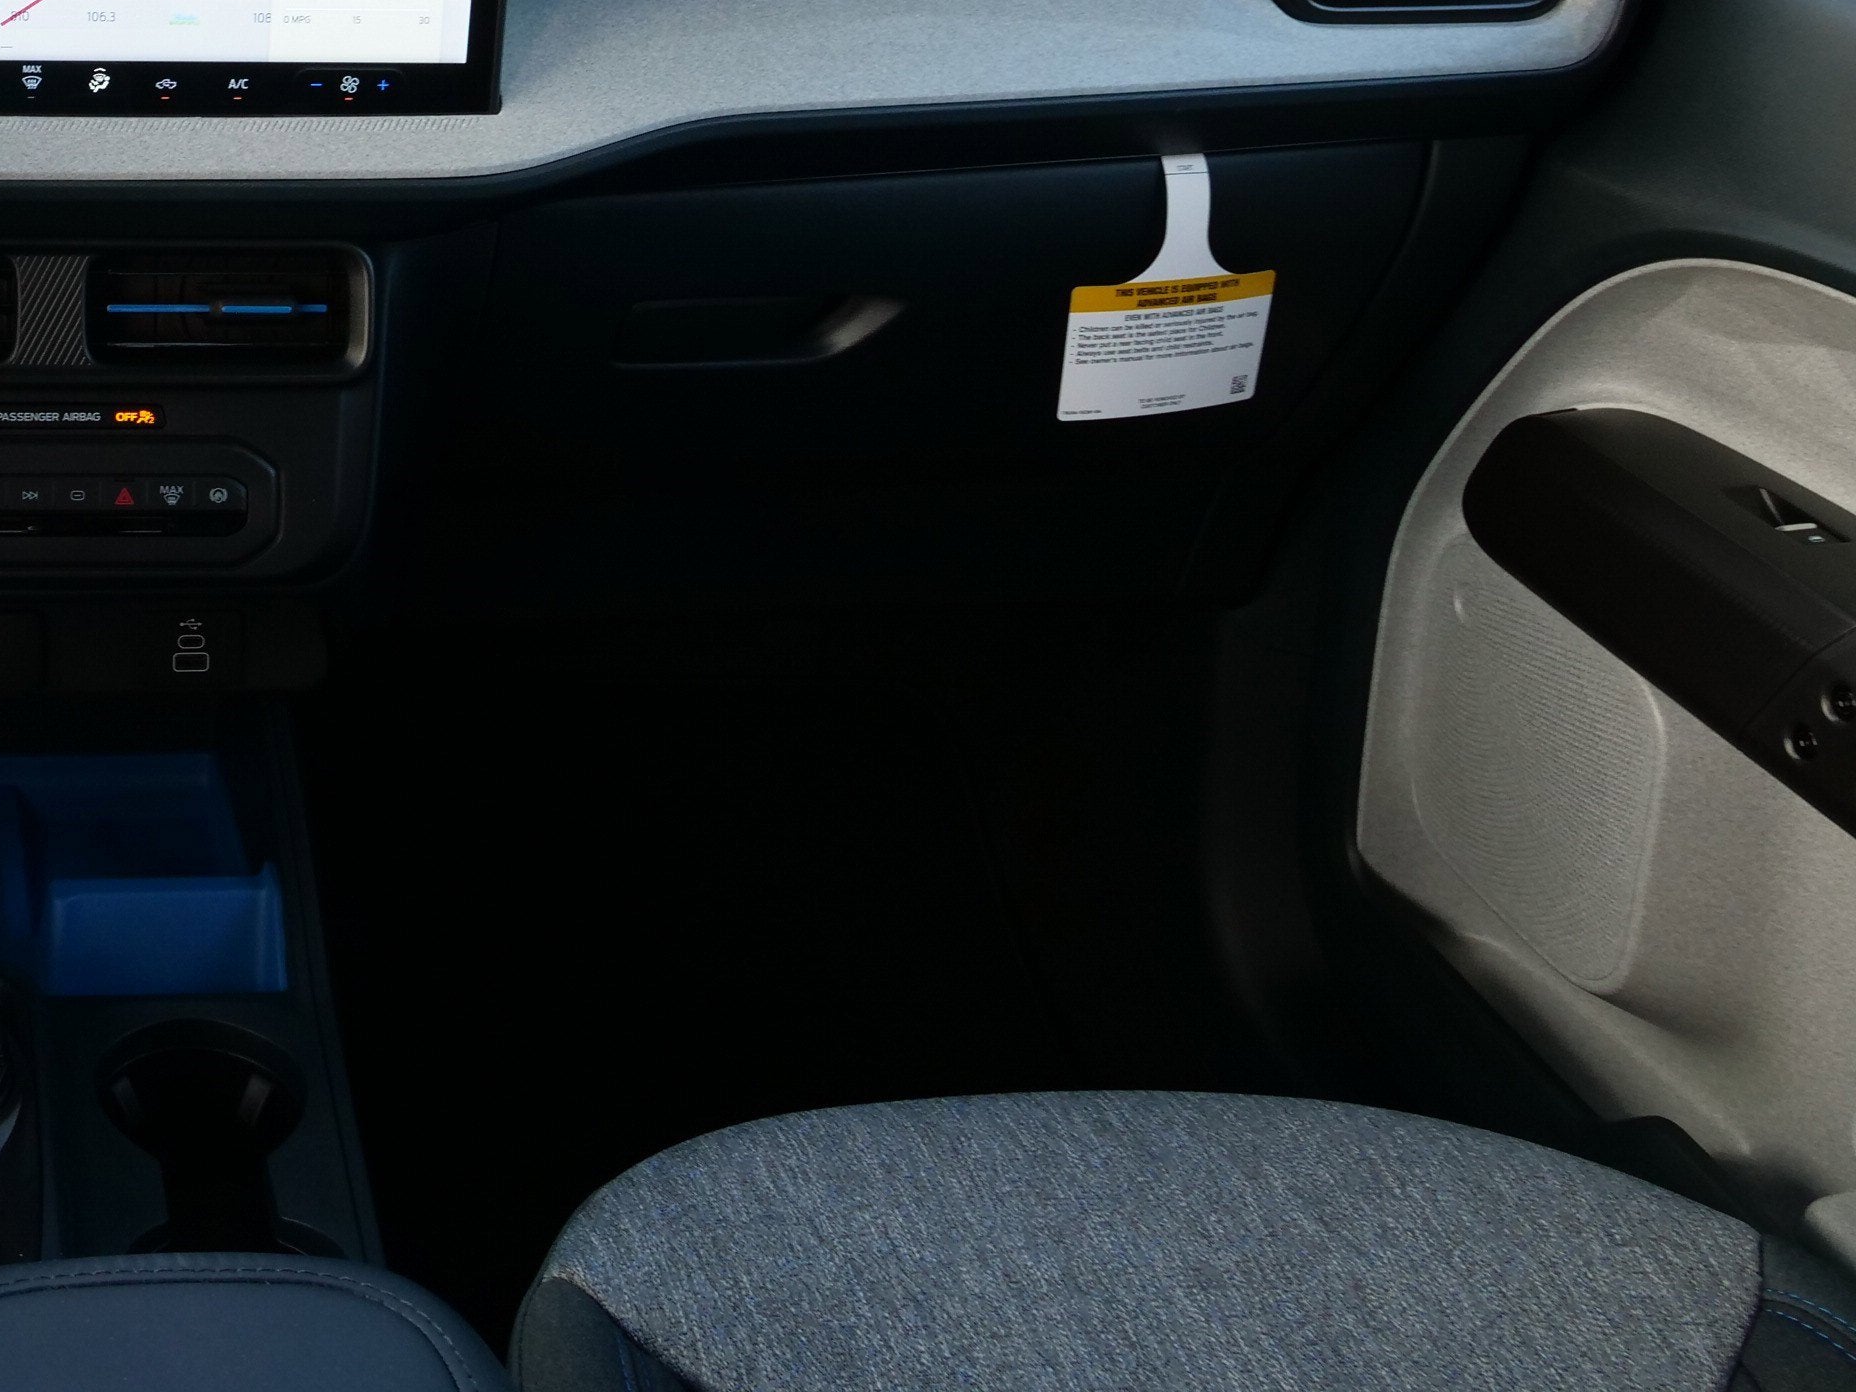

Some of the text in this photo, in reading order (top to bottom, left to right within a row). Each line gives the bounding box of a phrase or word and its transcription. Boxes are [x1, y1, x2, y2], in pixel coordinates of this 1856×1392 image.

[87, 12, 116, 22] 106.3
[419, 16, 430, 24] 30
[22, 65, 43, 74] MAX
[228, 79, 249, 90] A/C
[62, 412, 101, 422] AIRBAG
[115, 412, 138, 423] OFF
[159, 485, 184, 495] MAX
